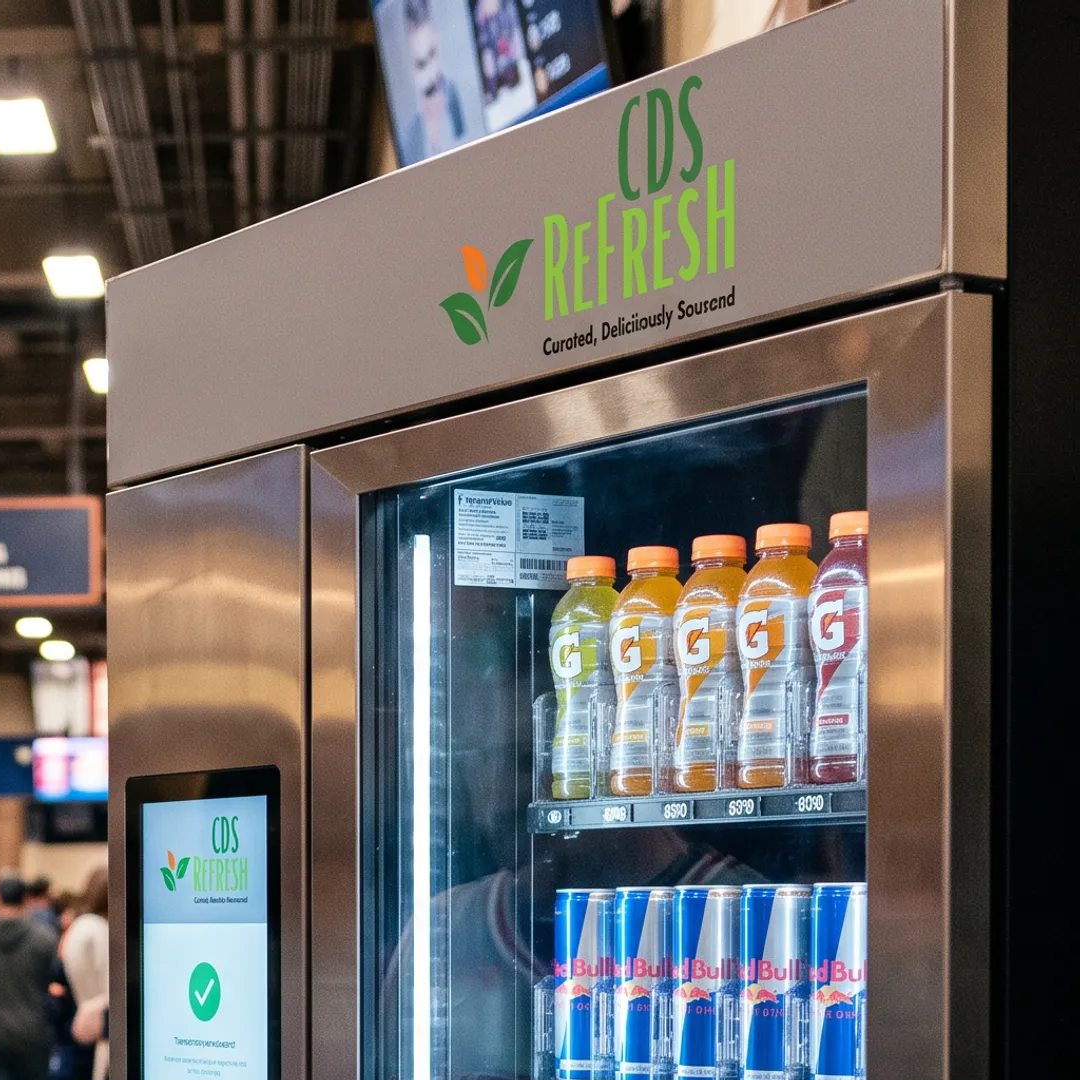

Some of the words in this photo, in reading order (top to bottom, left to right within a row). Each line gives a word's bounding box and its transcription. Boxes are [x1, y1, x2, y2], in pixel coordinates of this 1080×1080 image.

[618, 75, 704, 201] CDS
[678, 617, 710, 665] G
[739, 609, 769, 659] G
[812, 599, 844, 651] G
[552, 632, 582, 679] G
[611, 626, 642, 673] G
[211, 815, 240, 854] CDS
[691, 957, 731, 980] Bull
[757, 958, 800, 981] Bull
